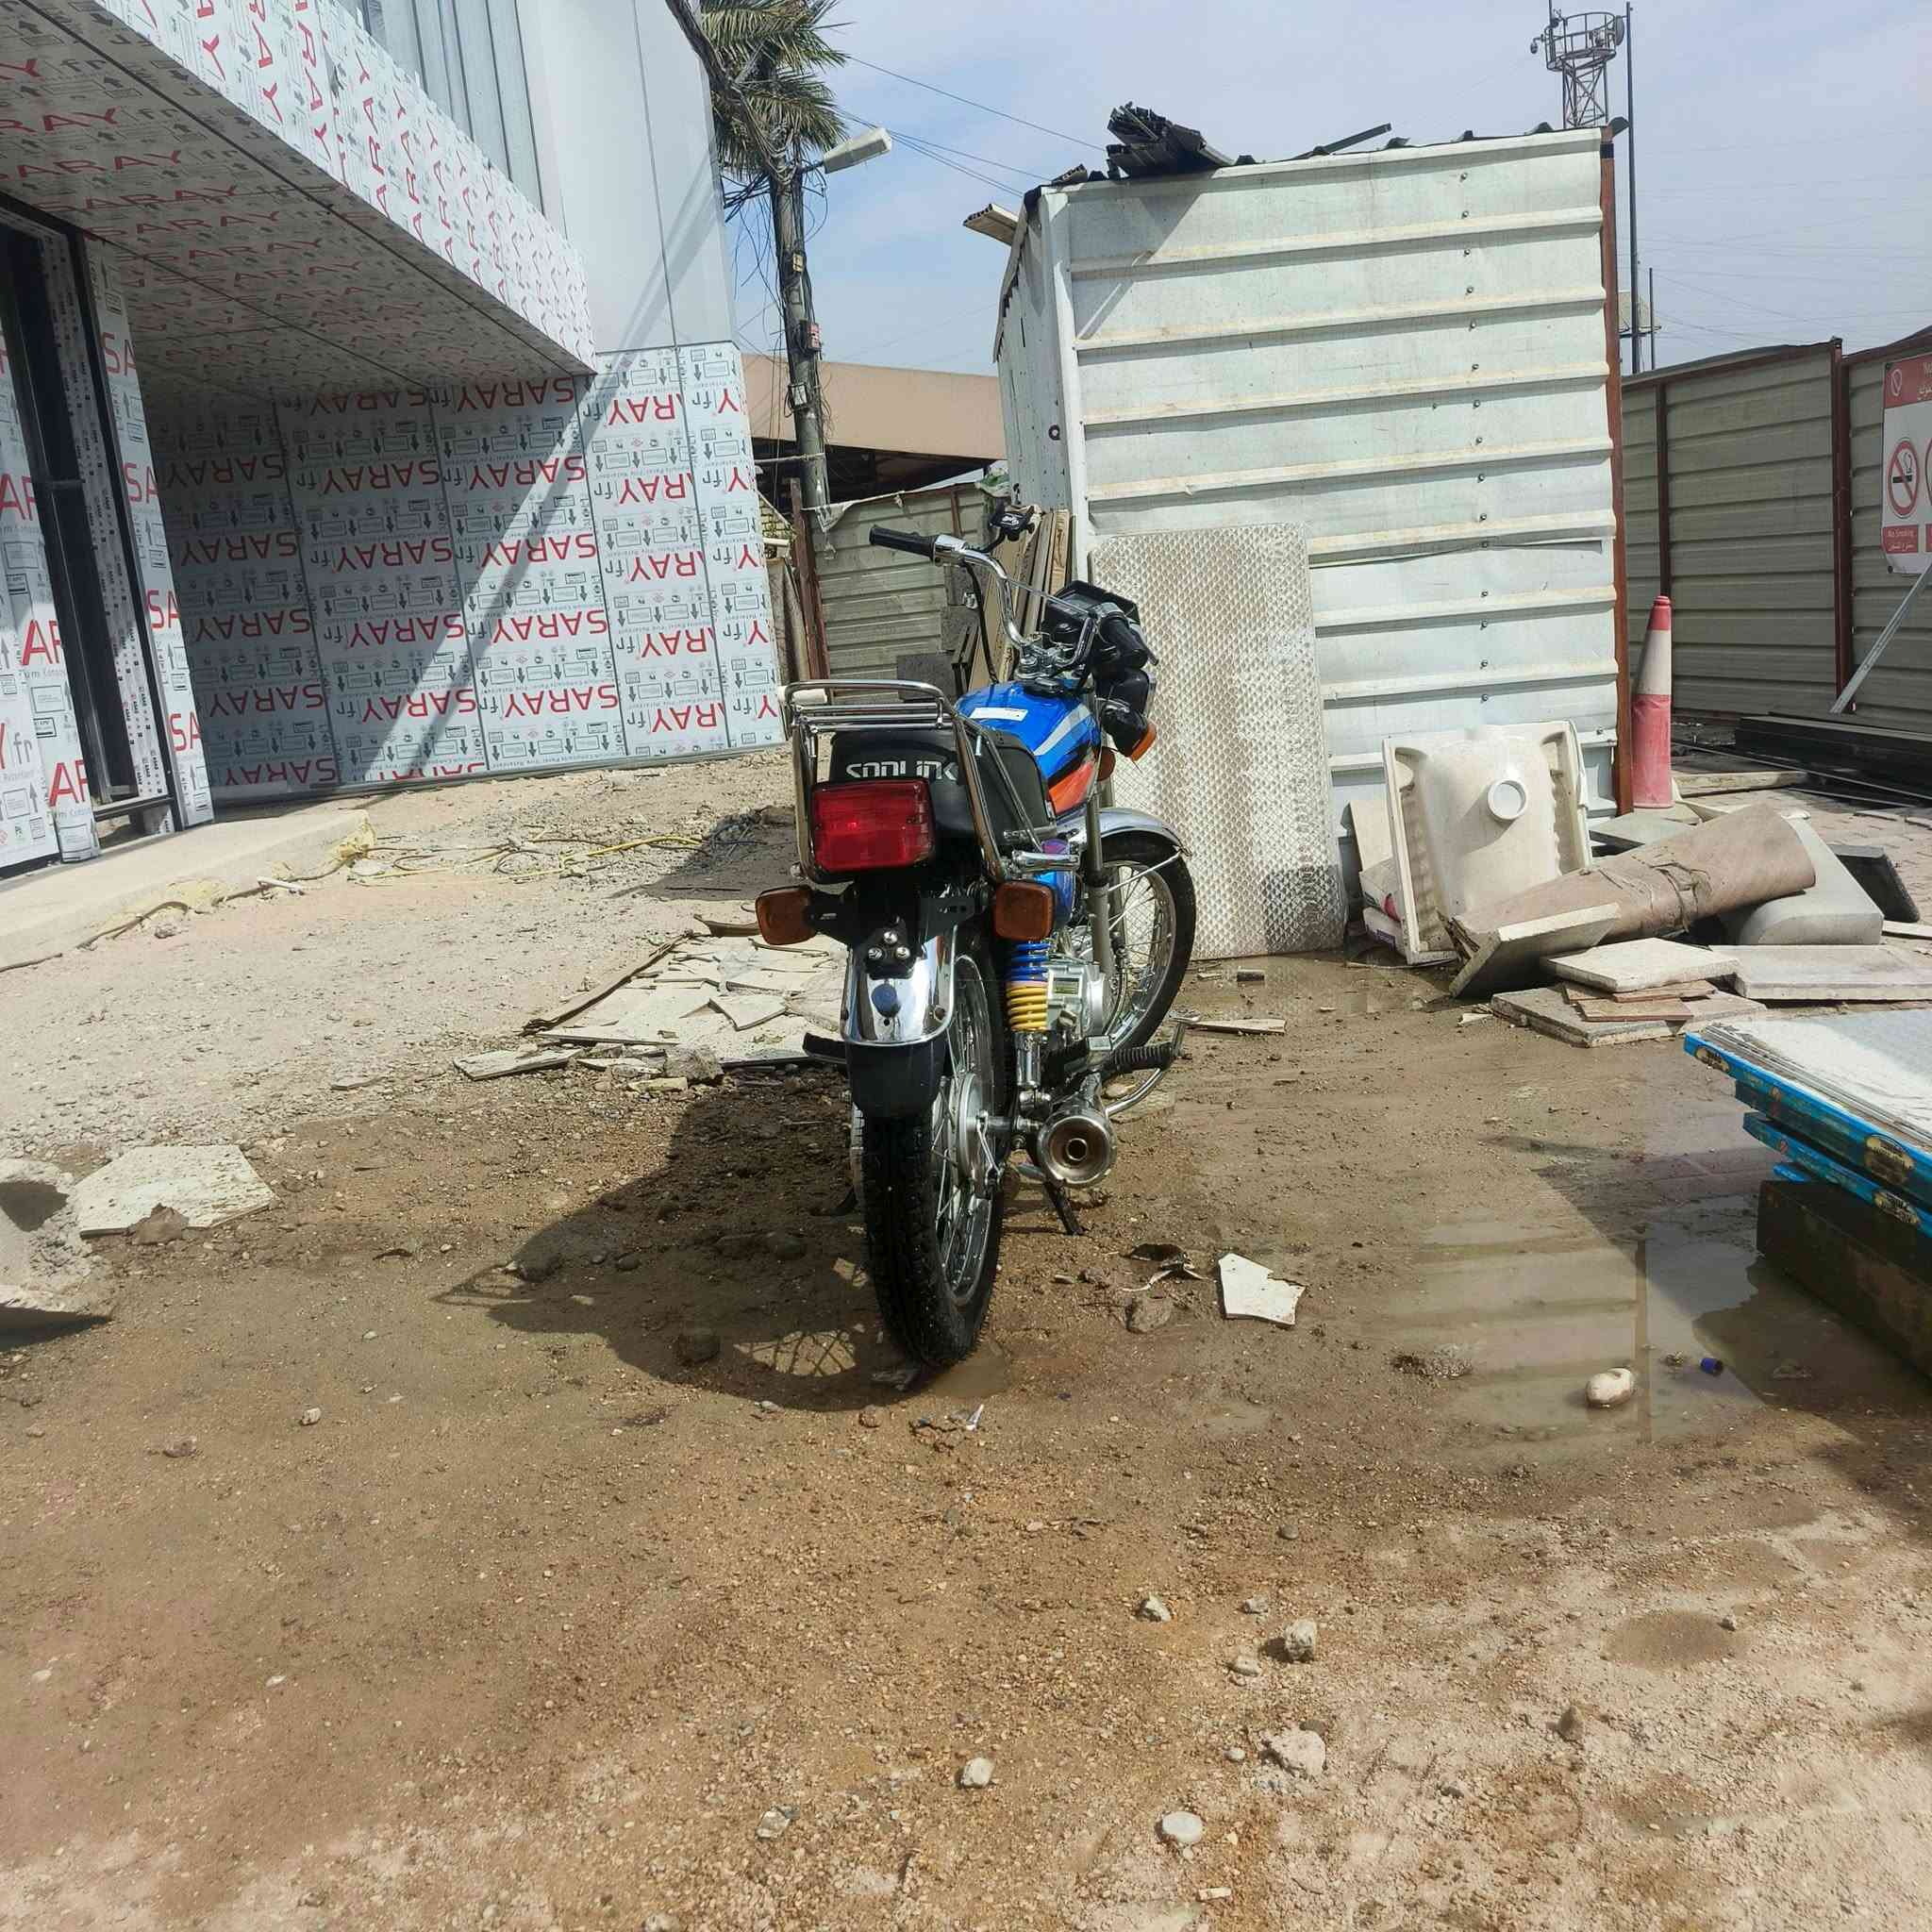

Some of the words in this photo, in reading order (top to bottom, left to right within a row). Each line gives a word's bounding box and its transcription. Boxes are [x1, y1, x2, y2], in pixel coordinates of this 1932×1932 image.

[458, 377, 575, 411] SARAY
[323, 459, 440, 494] SARAY
[469, 456, 587, 491] SARAY
[338, 536, 453, 572] SARAY
[481, 533, 597, 567] SARAY
[195, 608, 311, 642] SARAY
[350, 613, 464, 647] SARAY
[492, 609, 608, 643] SARAY
[208, 683, 325, 718] SARAY
[362, 689, 477, 723] SARAY
[504, 685, 619, 718] SARAY
